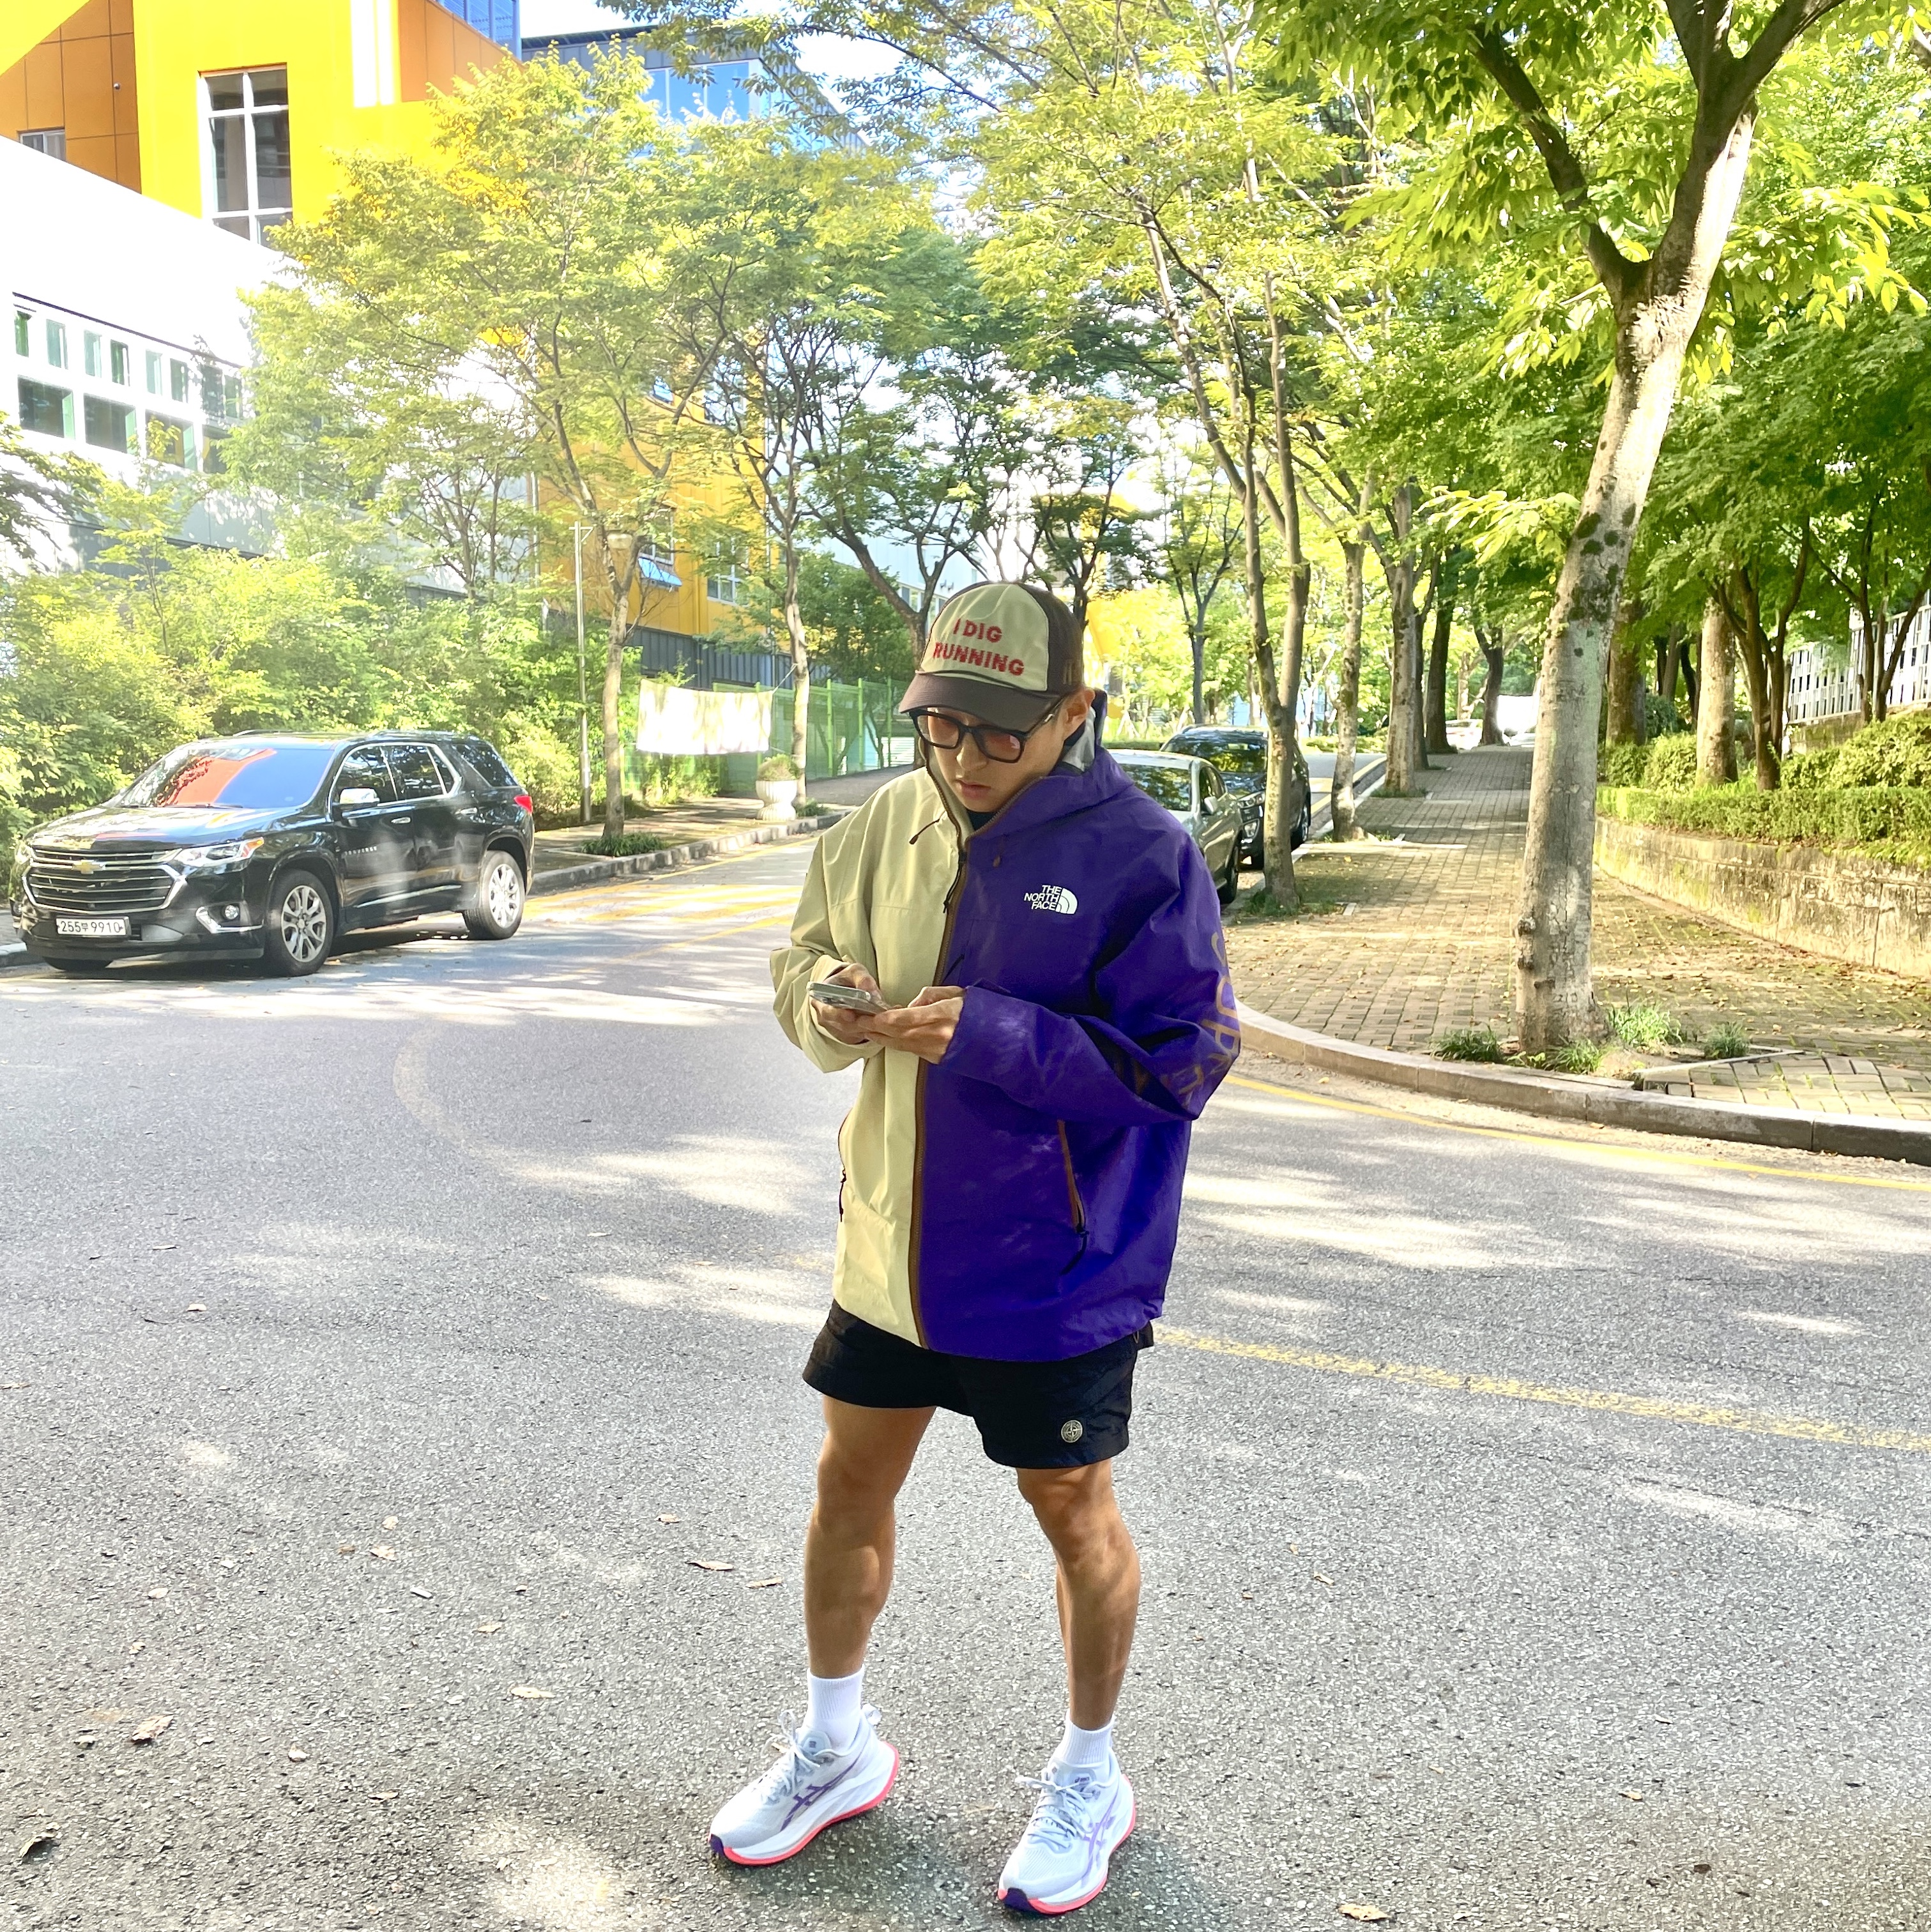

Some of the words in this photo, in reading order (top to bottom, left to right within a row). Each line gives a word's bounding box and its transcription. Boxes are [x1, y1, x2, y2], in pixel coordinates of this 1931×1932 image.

[953, 618, 961, 635] I
[962, 620, 1003, 643] DIG
[933, 642, 1025, 676] RUNNING
[1042, 885, 1062, 895] THE
[1024, 892, 1060, 903] NORTH
[1031, 901, 1057, 911] FACE
